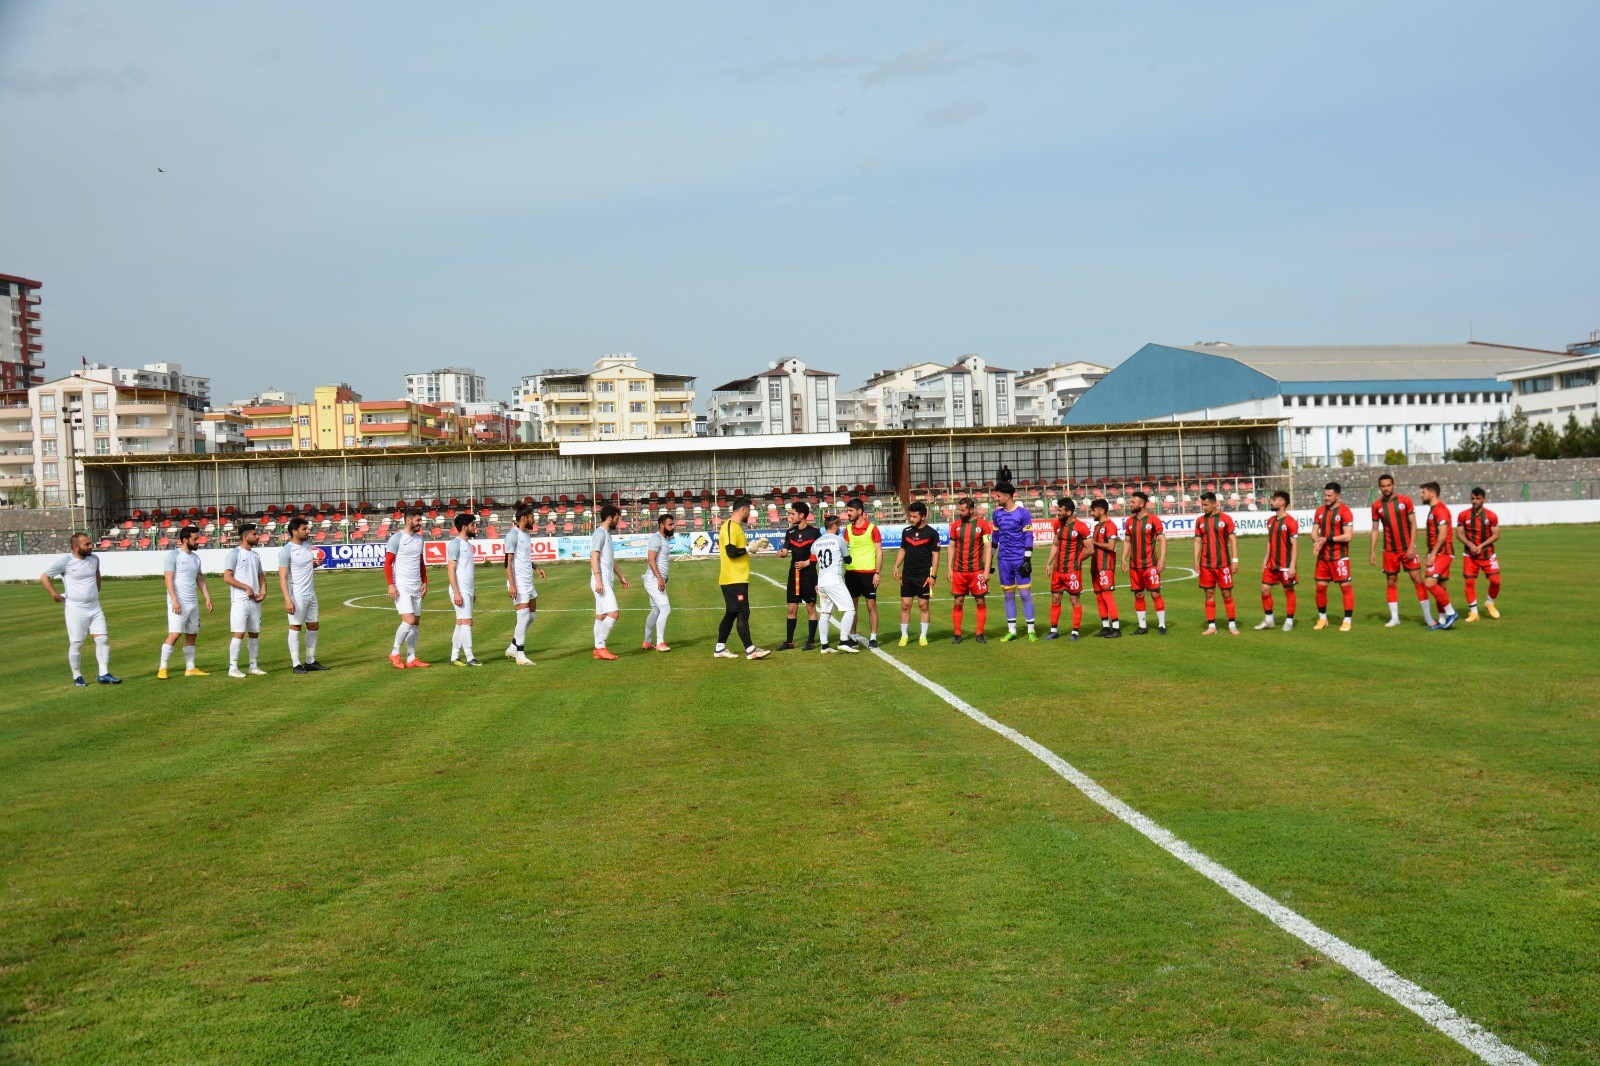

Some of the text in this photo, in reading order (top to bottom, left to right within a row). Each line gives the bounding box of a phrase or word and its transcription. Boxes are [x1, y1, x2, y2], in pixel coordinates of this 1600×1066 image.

[817, 549, 833, 570] 10
[1336, 566, 1348, 577] 15
[1069, 579, 1080, 590] 20
[1150, 574, 1160, 585] 12
[1223, 574, 1232, 584] 11
